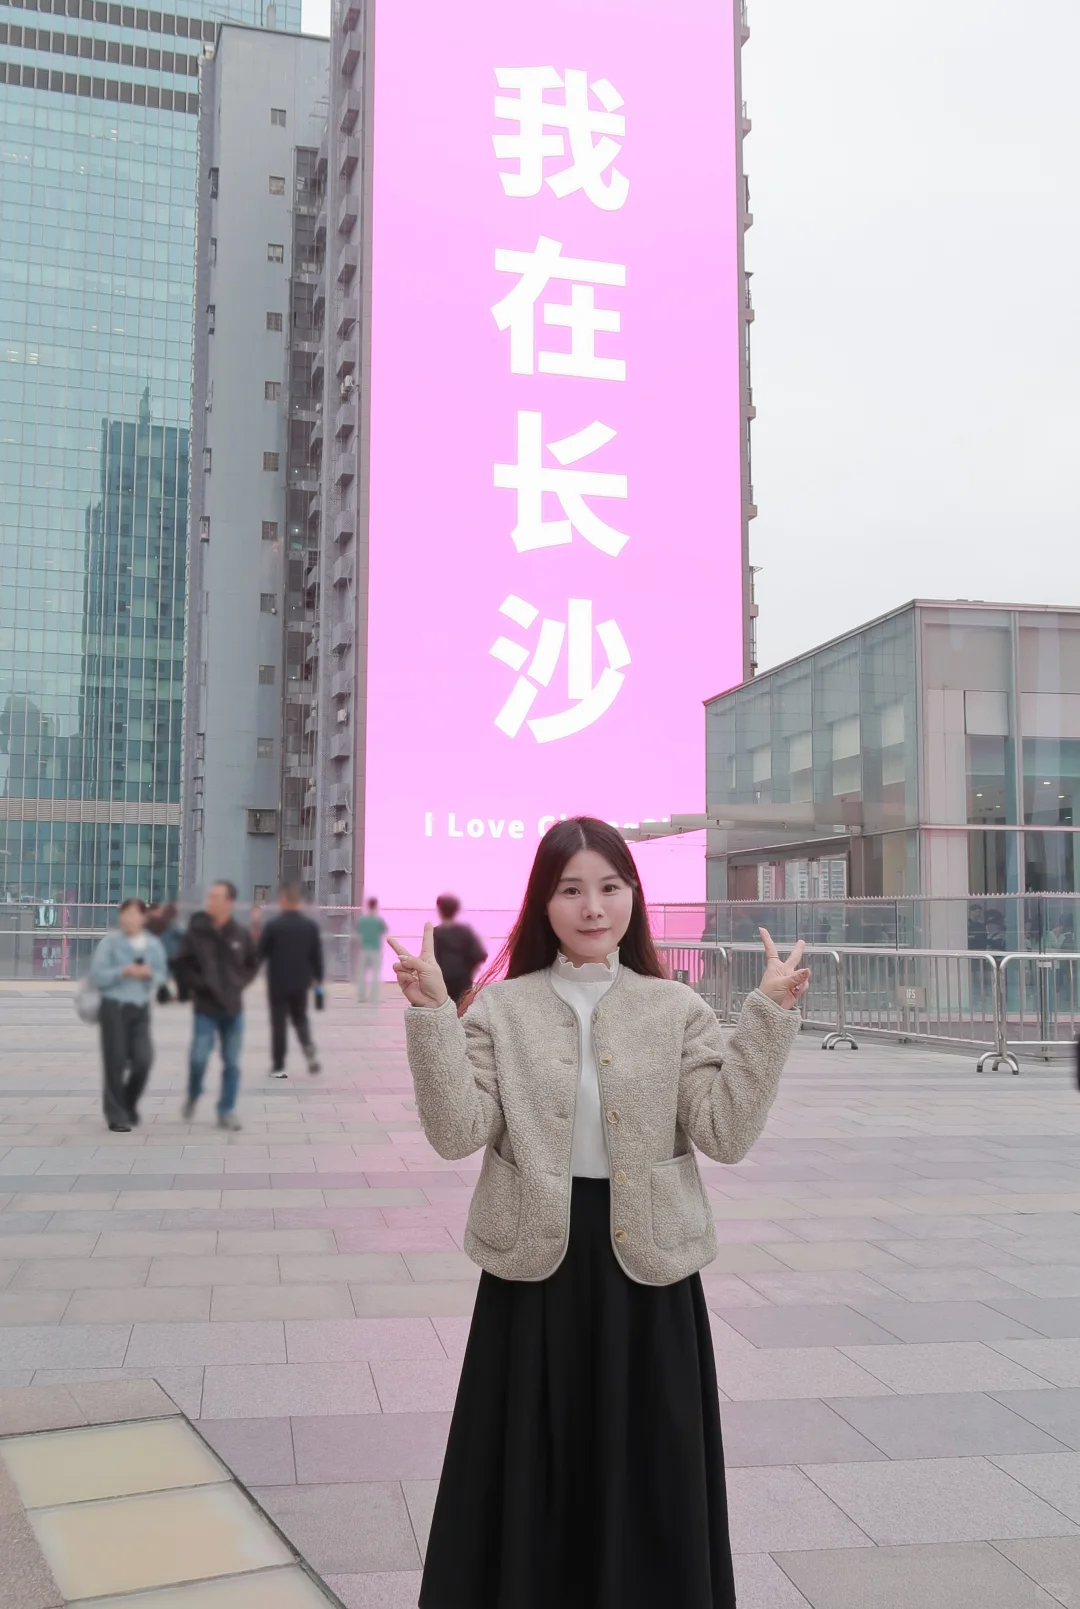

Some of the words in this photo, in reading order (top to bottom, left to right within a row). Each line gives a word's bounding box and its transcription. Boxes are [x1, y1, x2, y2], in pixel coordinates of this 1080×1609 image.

[489, 66, 631, 743] 我在长沙
[425, 812, 433, 836] I
[448, 813, 524, 839] Love
